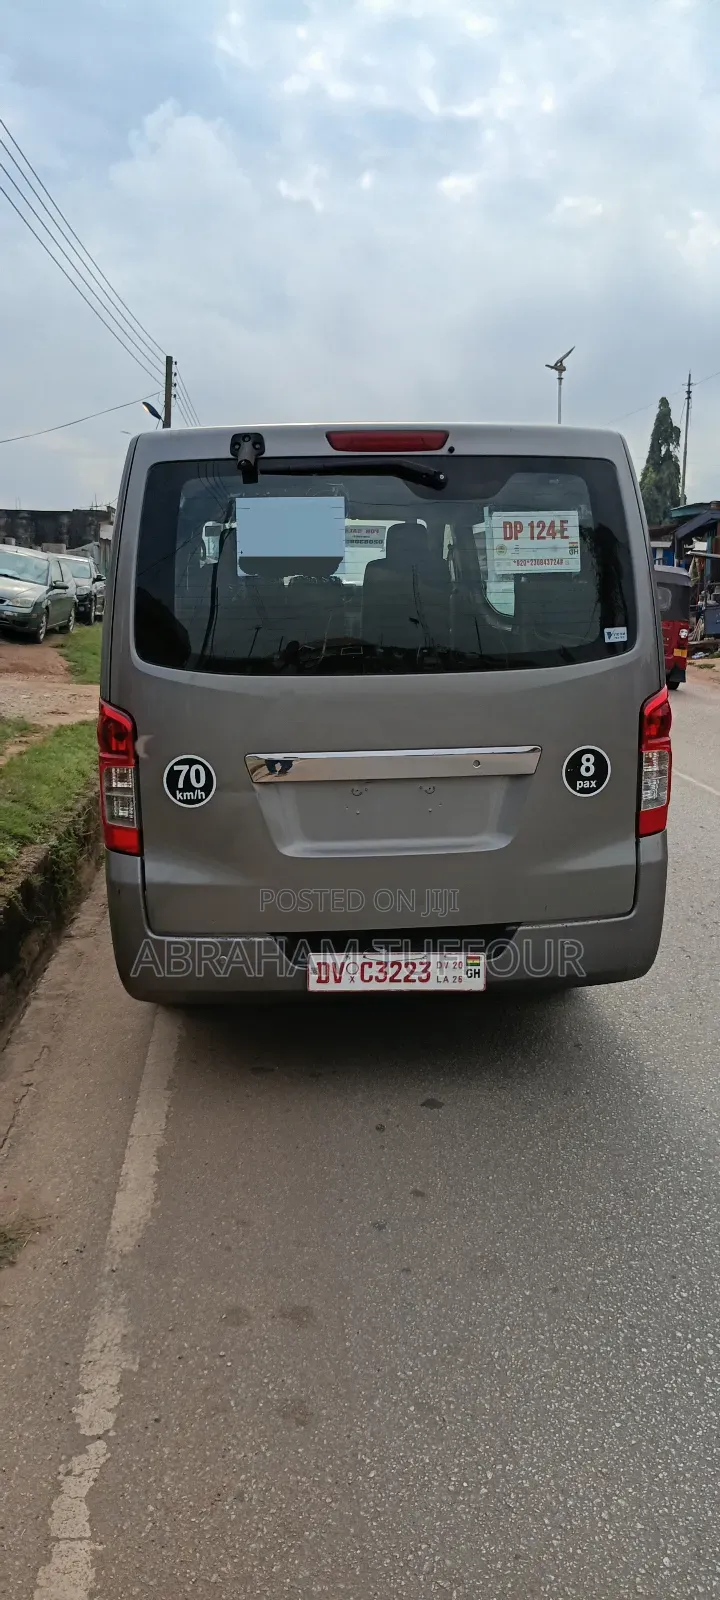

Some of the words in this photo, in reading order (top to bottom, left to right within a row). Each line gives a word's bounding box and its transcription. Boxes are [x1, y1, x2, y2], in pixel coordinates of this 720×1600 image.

[503, 520, 524, 541] DP
[580, 753, 595, 777] 8
[173, 764, 206, 789] 70
[576, 779, 597, 791] pax
[176, 789, 206, 800] km/h
[316, 961, 345, 984] DV
[360, 961, 431, 983] C3223
[436, 976, 449, 984] LA
[466, 968, 481, 979] GH
